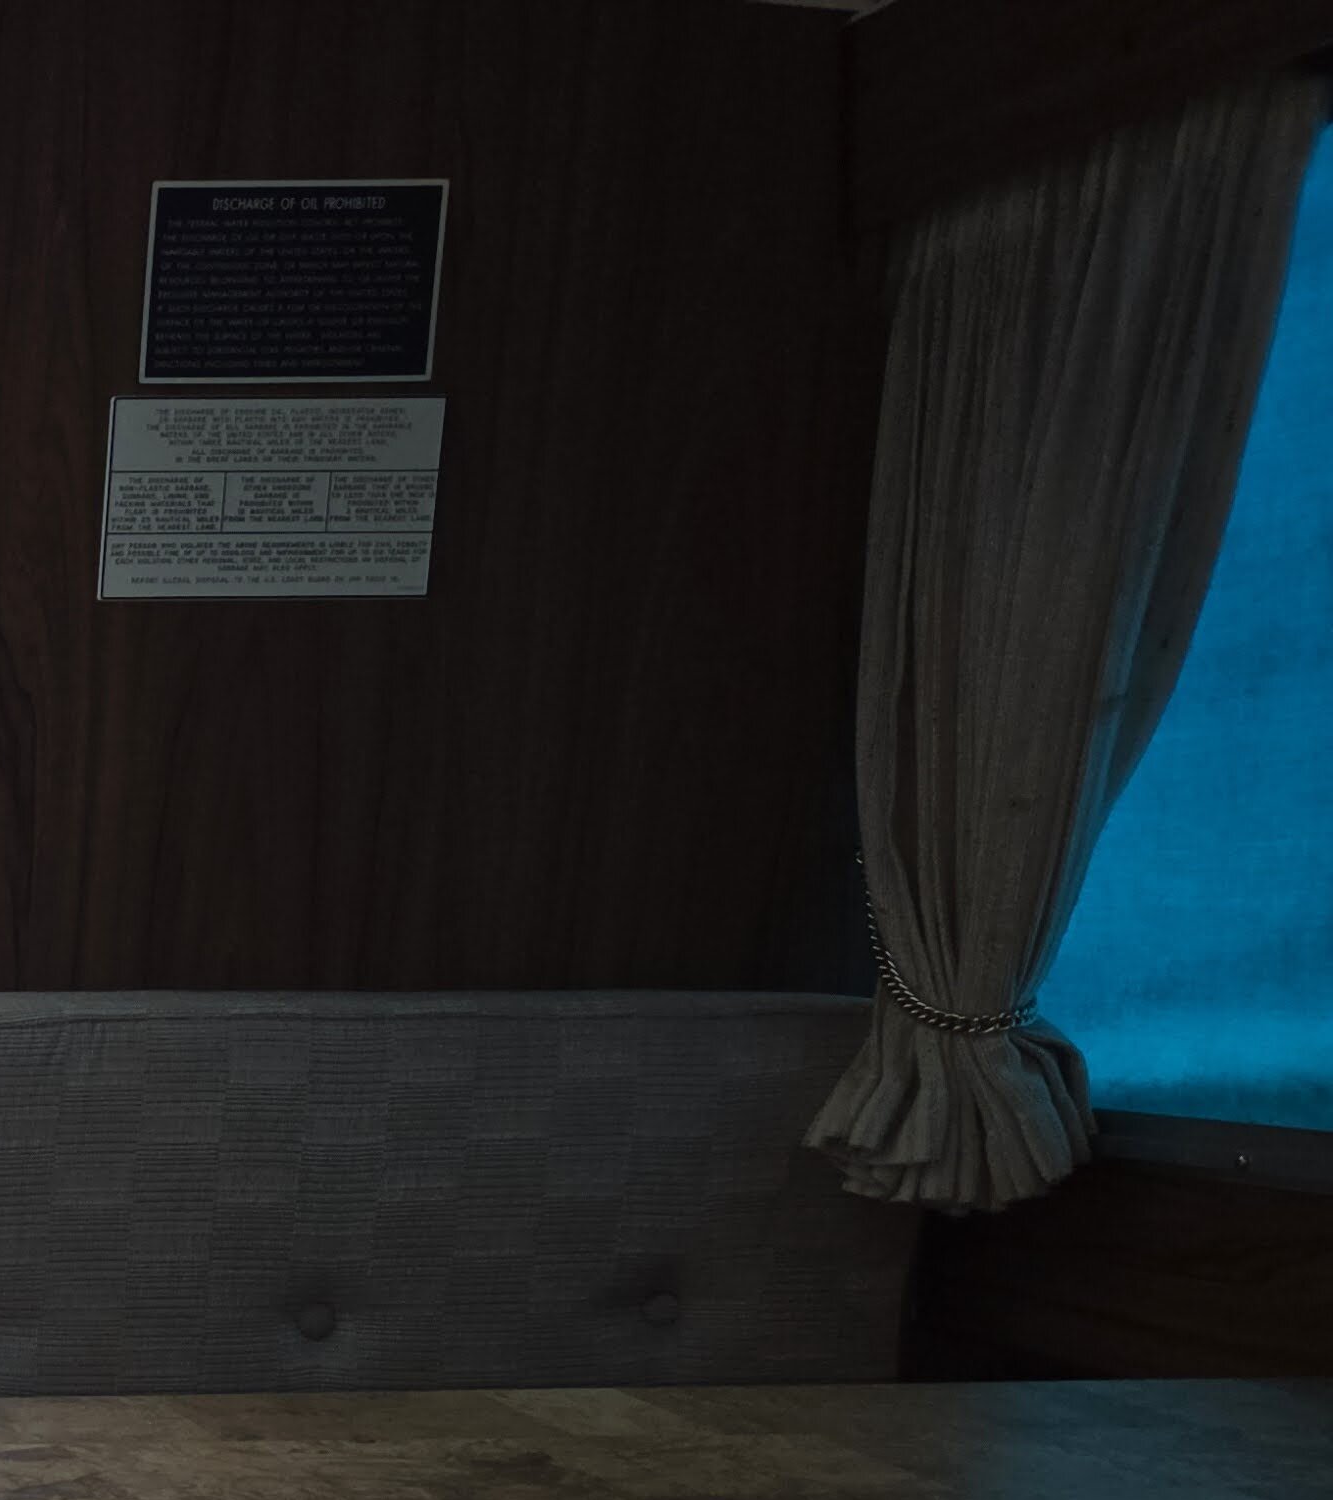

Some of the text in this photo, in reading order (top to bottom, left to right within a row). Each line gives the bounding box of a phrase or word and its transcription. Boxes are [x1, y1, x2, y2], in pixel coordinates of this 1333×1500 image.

[213, 196, 387, 210] DISCHARGE OF OIL PROHIBITED
